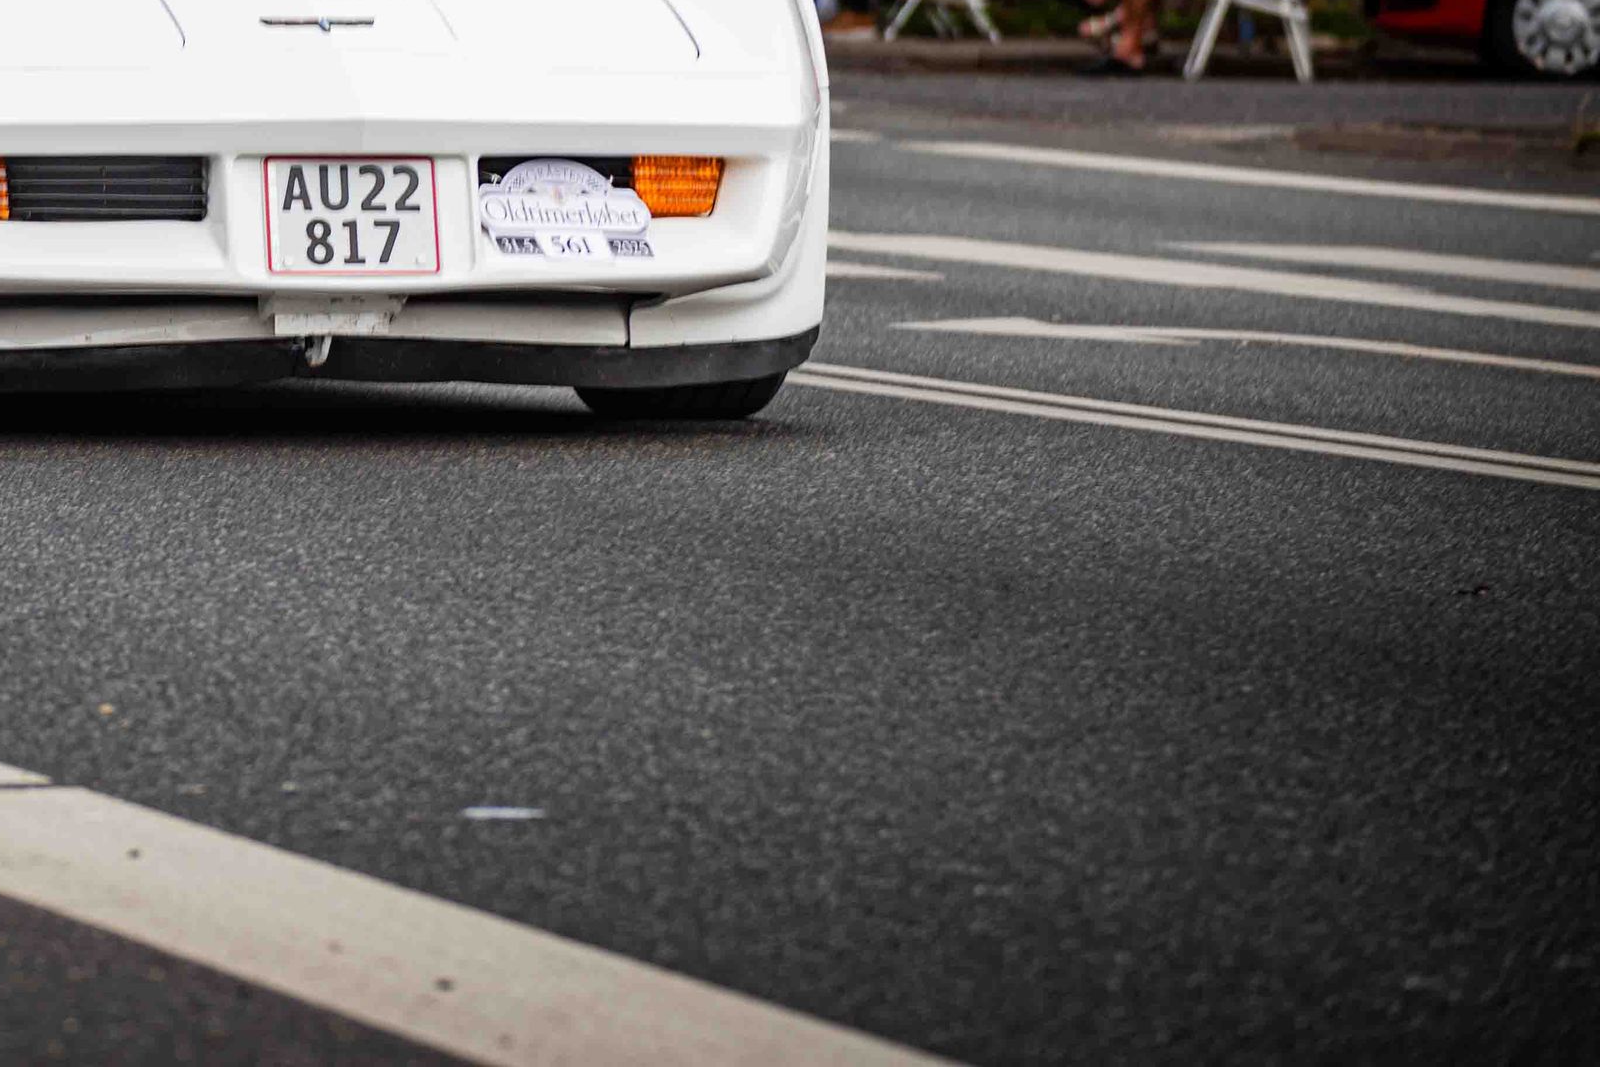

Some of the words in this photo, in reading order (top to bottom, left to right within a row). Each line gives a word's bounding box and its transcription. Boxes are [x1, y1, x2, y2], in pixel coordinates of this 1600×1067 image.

[282, 164, 421, 212] AU22
[305, 220, 401, 264] 817
[551, 235, 592, 254] 561
